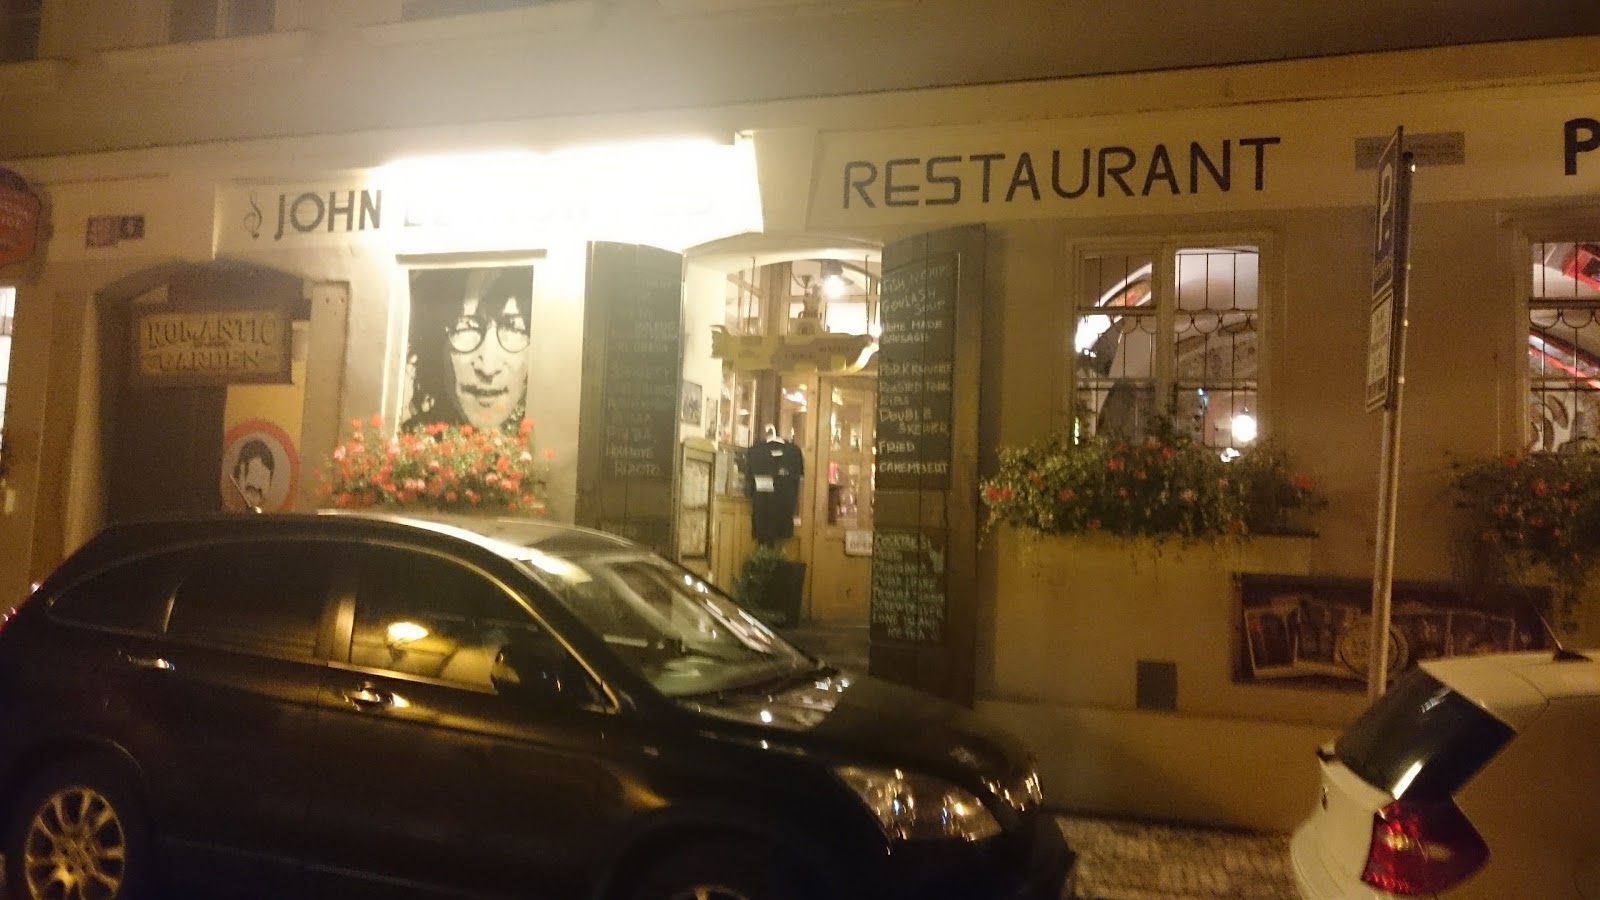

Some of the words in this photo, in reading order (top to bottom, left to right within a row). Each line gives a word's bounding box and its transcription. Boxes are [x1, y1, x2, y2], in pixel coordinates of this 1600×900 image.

[843, 137, 1281, 209] RESTAURANT
[274, 189, 382, 241] JOHN
[881, 289, 936, 314] GOULASH
[878, 440, 915, 456] FRIED
